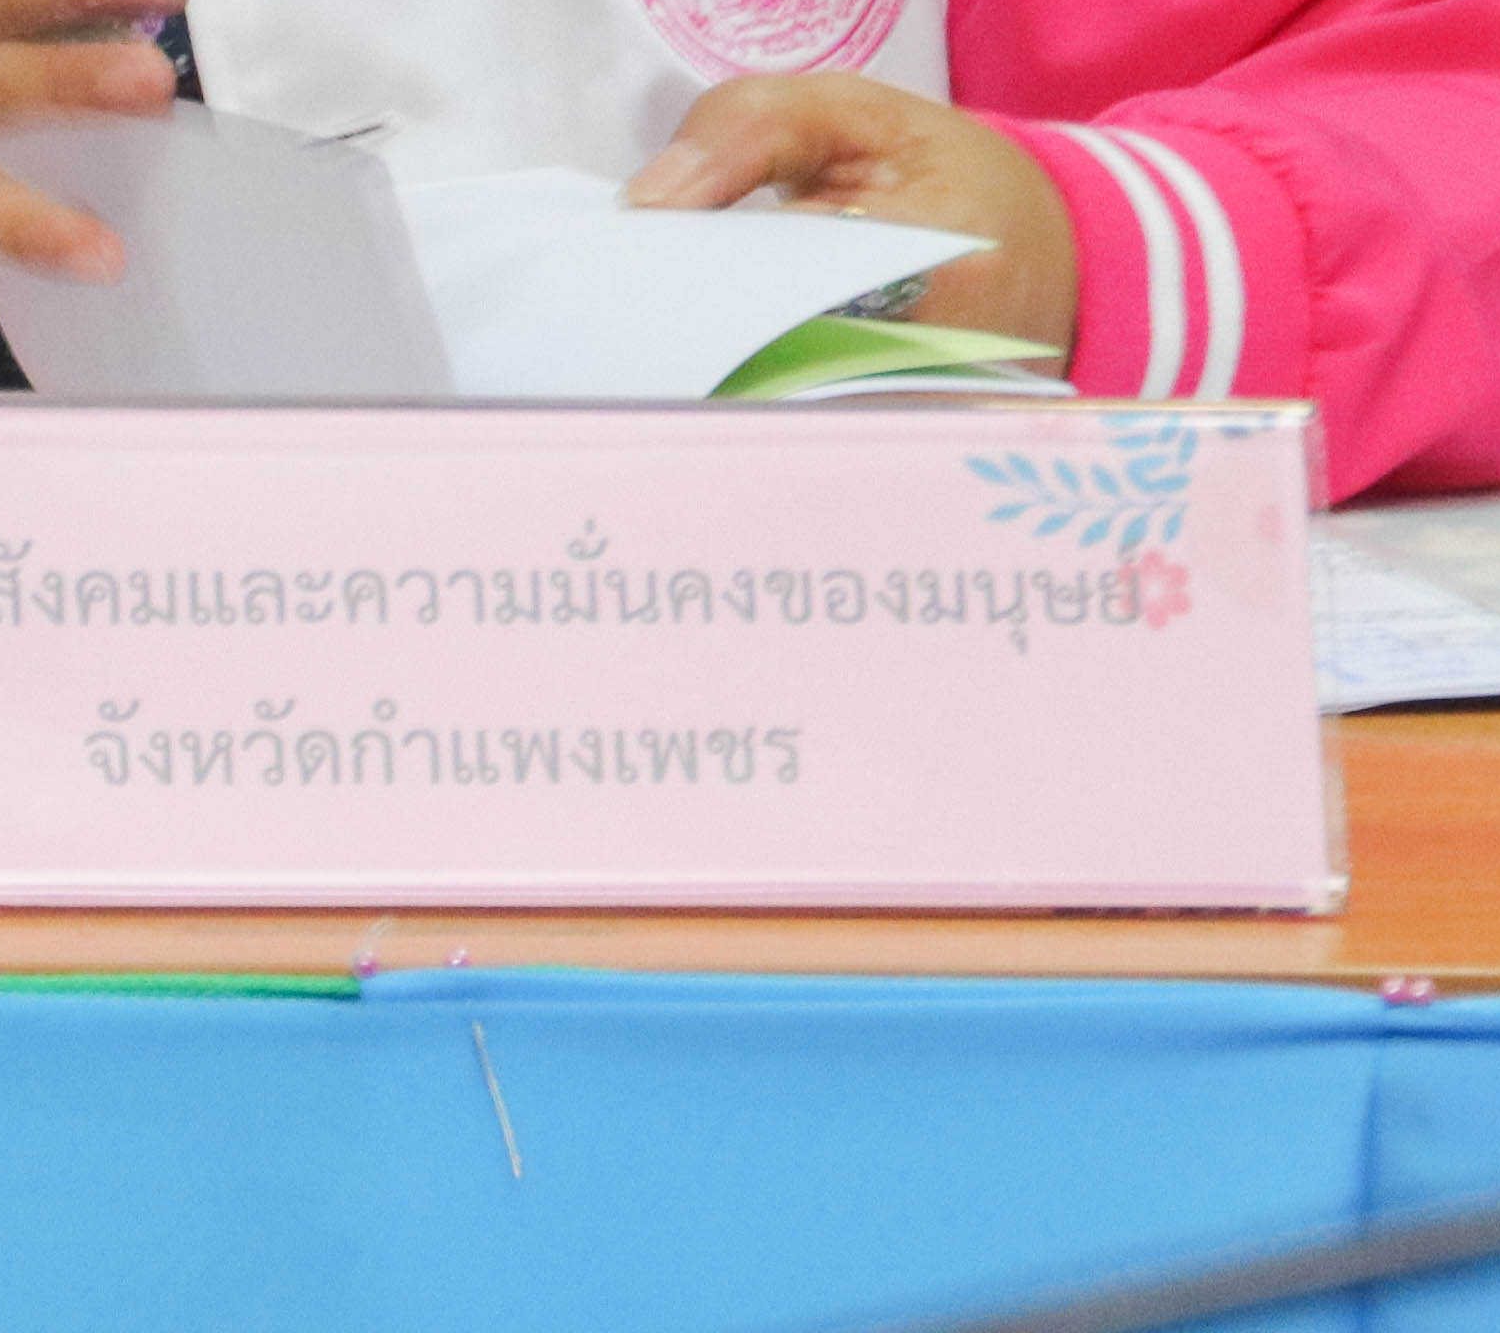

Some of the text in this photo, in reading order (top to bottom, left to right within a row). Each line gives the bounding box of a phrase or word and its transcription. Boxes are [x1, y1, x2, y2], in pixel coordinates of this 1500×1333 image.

[83, 696, 802, 788] จังหวัดกำแพงเพชร
